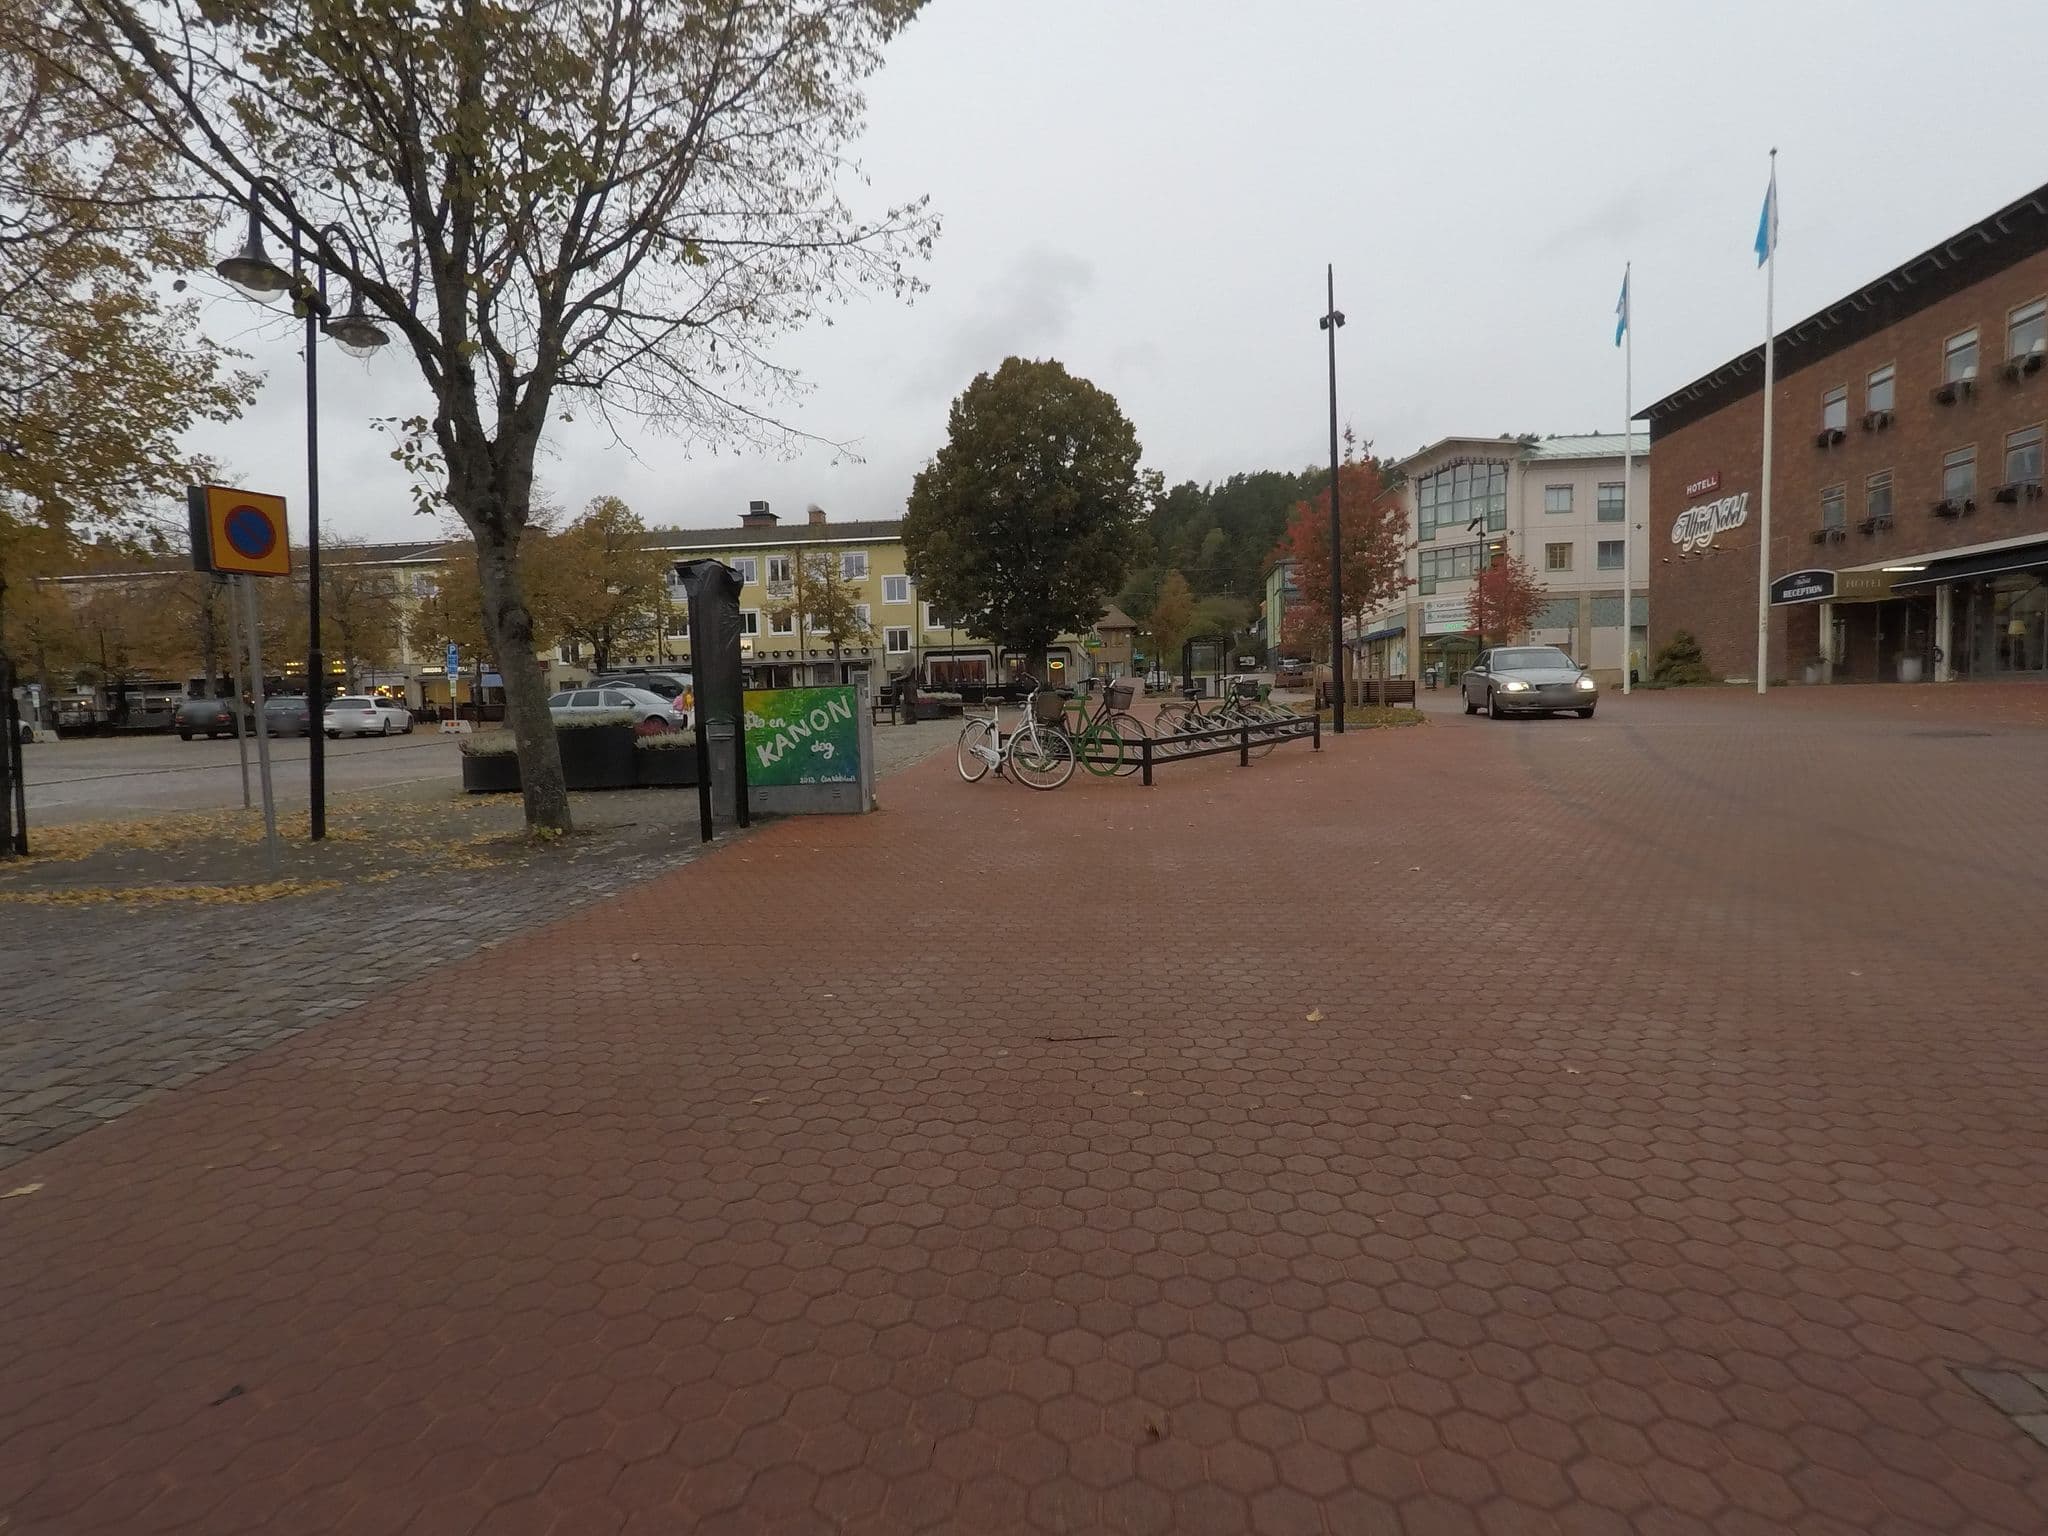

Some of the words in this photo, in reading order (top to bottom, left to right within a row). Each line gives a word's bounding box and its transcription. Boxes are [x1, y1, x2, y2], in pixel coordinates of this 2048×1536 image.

[1686, 476, 1717, 495] HOTELL
[1783, 585, 1822, 598] RECEPTION
[756, 695, 852, 768] KANON
[769, 718, 786, 728] en
[811, 740, 835, 760] dag
